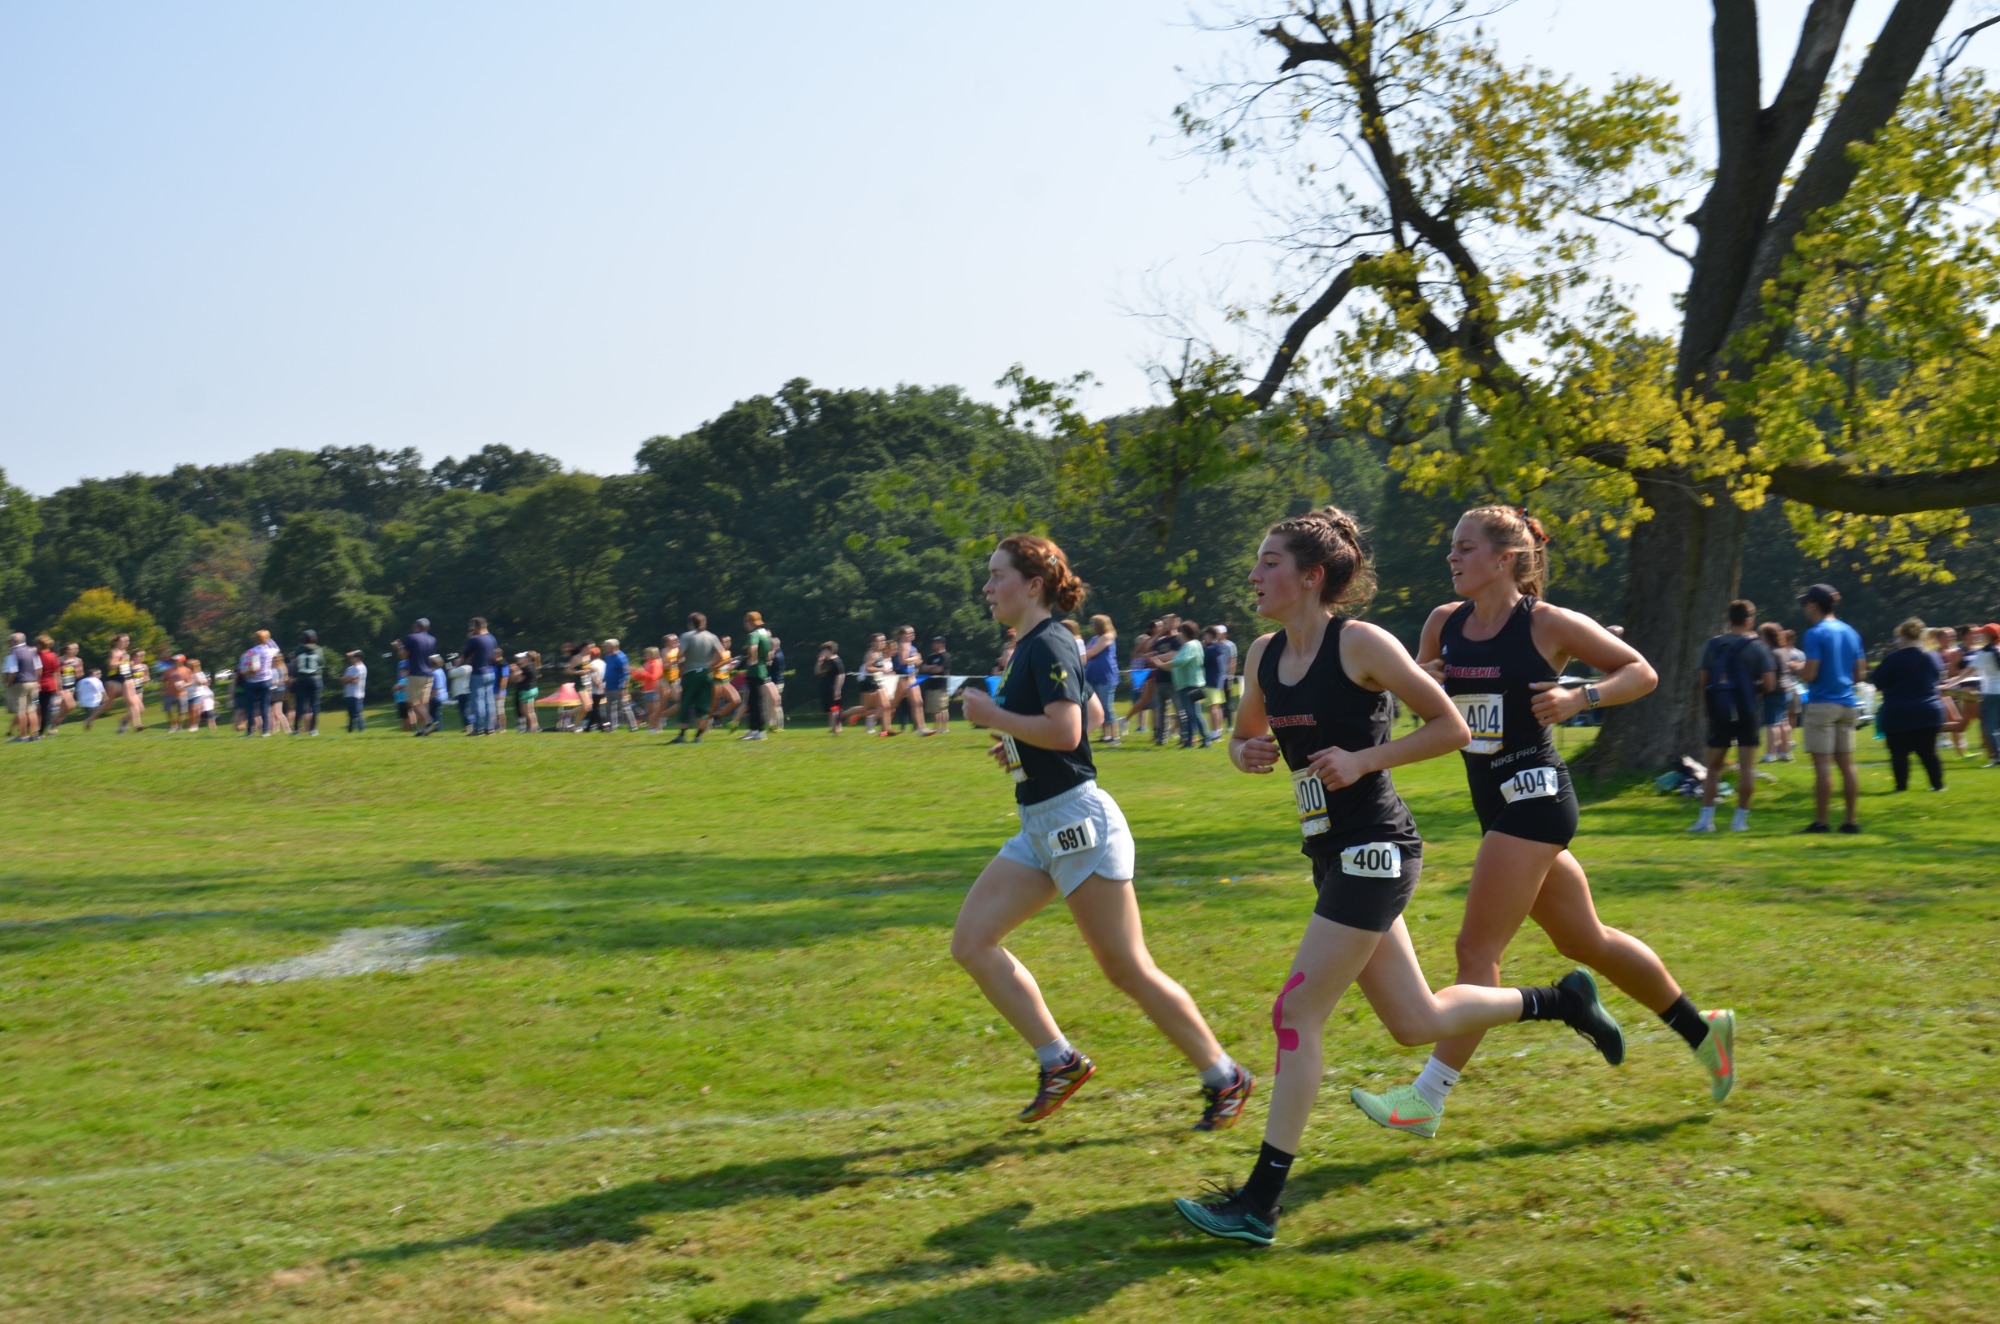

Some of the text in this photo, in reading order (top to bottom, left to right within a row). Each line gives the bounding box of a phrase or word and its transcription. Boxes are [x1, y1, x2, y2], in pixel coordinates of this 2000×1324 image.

[1467, 704, 1500, 734] 404
[1490, 746, 1537, 769] NIKE PRO
[1298, 777, 1322, 813] 00
[1513, 770, 1547, 795] 404
[1057, 825, 1087, 851] 691
[1353, 848, 1393, 871] 400
